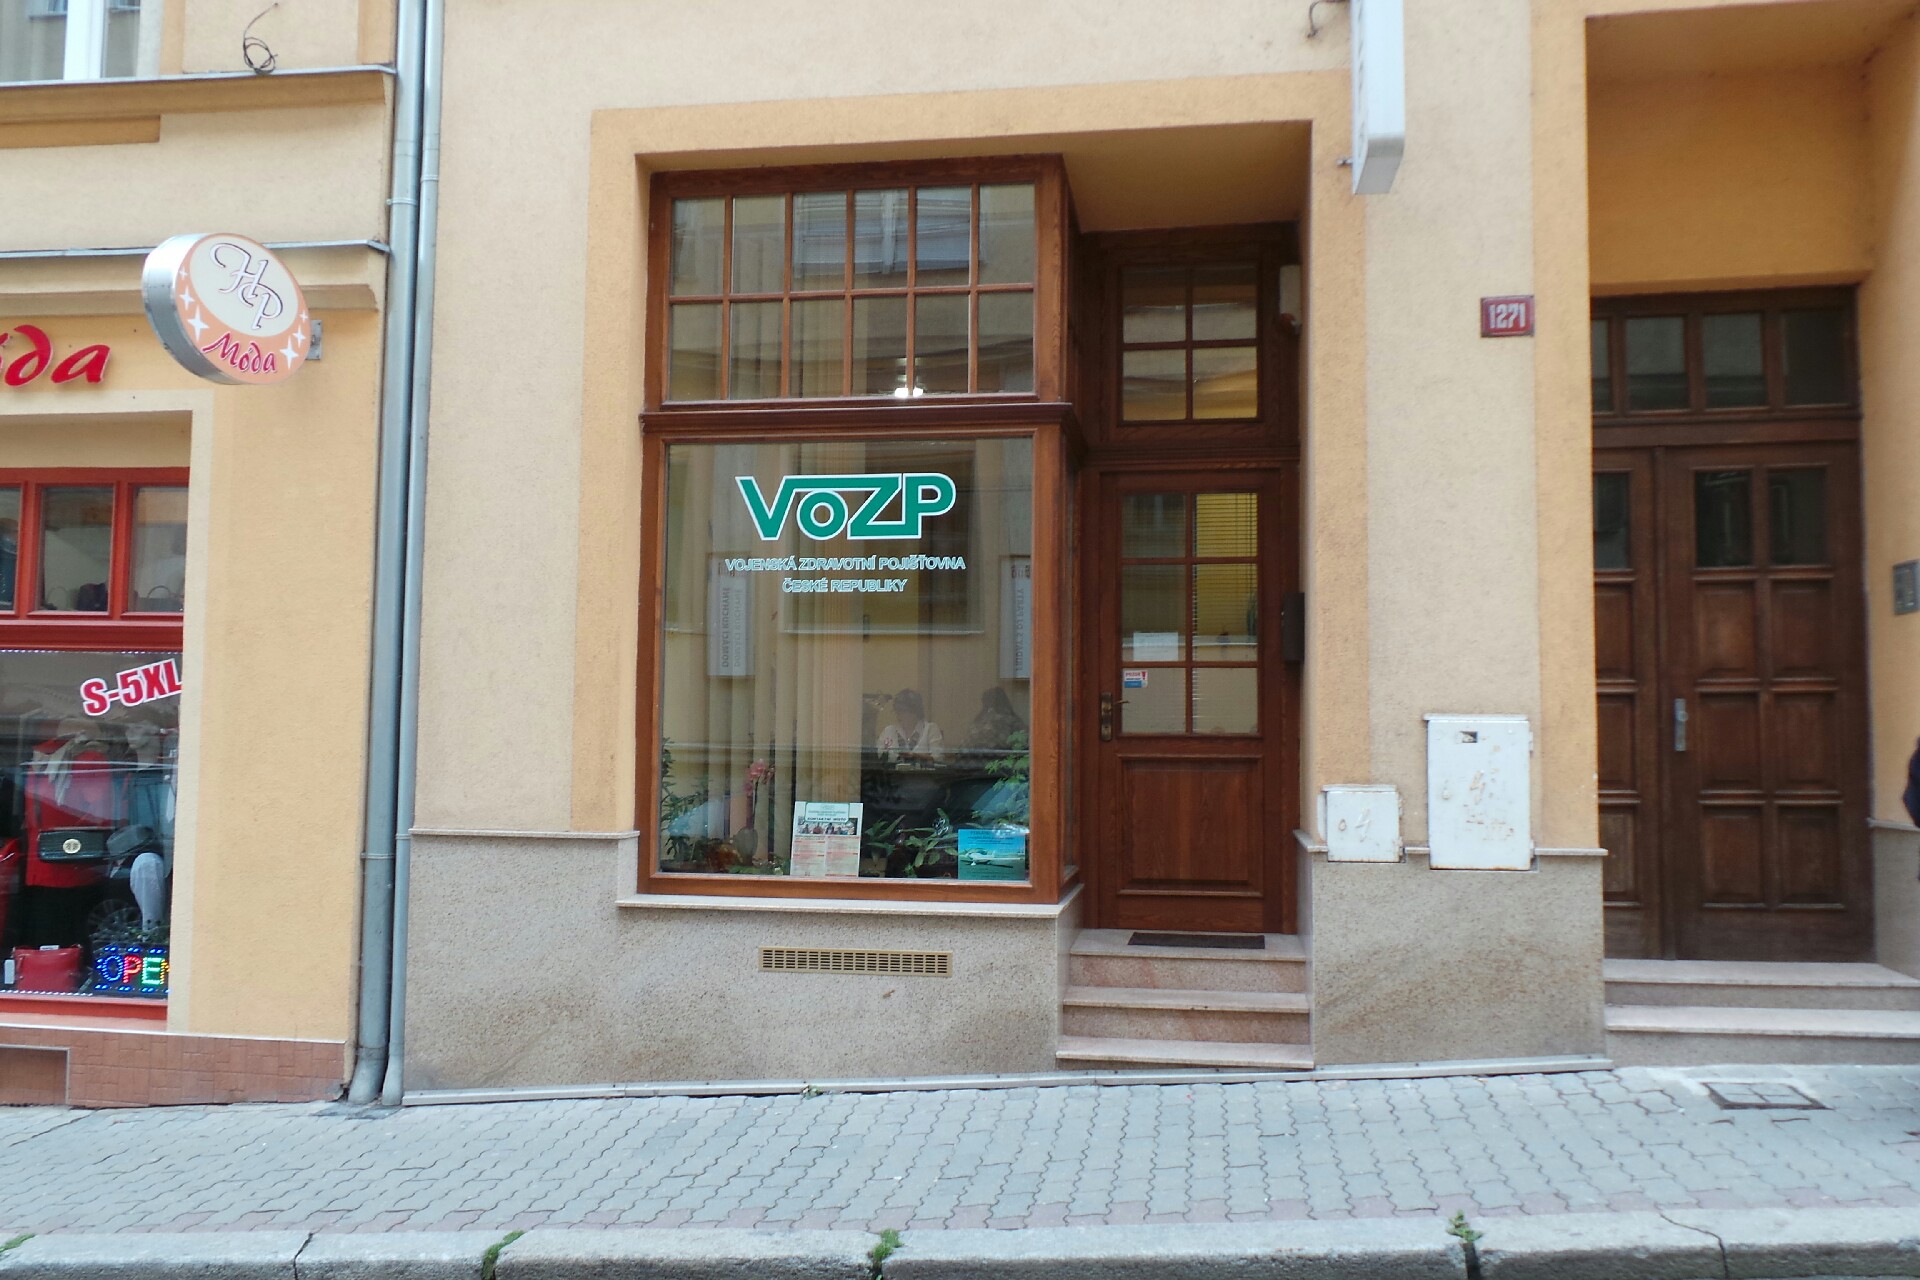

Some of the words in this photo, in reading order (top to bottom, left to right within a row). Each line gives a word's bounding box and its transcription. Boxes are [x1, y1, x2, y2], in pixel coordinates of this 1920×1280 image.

[1489, 302, 1526, 329] 1271
[0, 324, 111, 387] da
[725, 555, 798, 572] VOJENSKÁ
[799, 554, 877, 571] ZDRAVOTNÍ
[878, 554, 967, 571] POJIŠŤOVNA
[782, 577, 828, 593] ČESKÉ
[830, 578, 908, 593] REPUBLIKY
[81, 658, 182, 716] S-5XL
